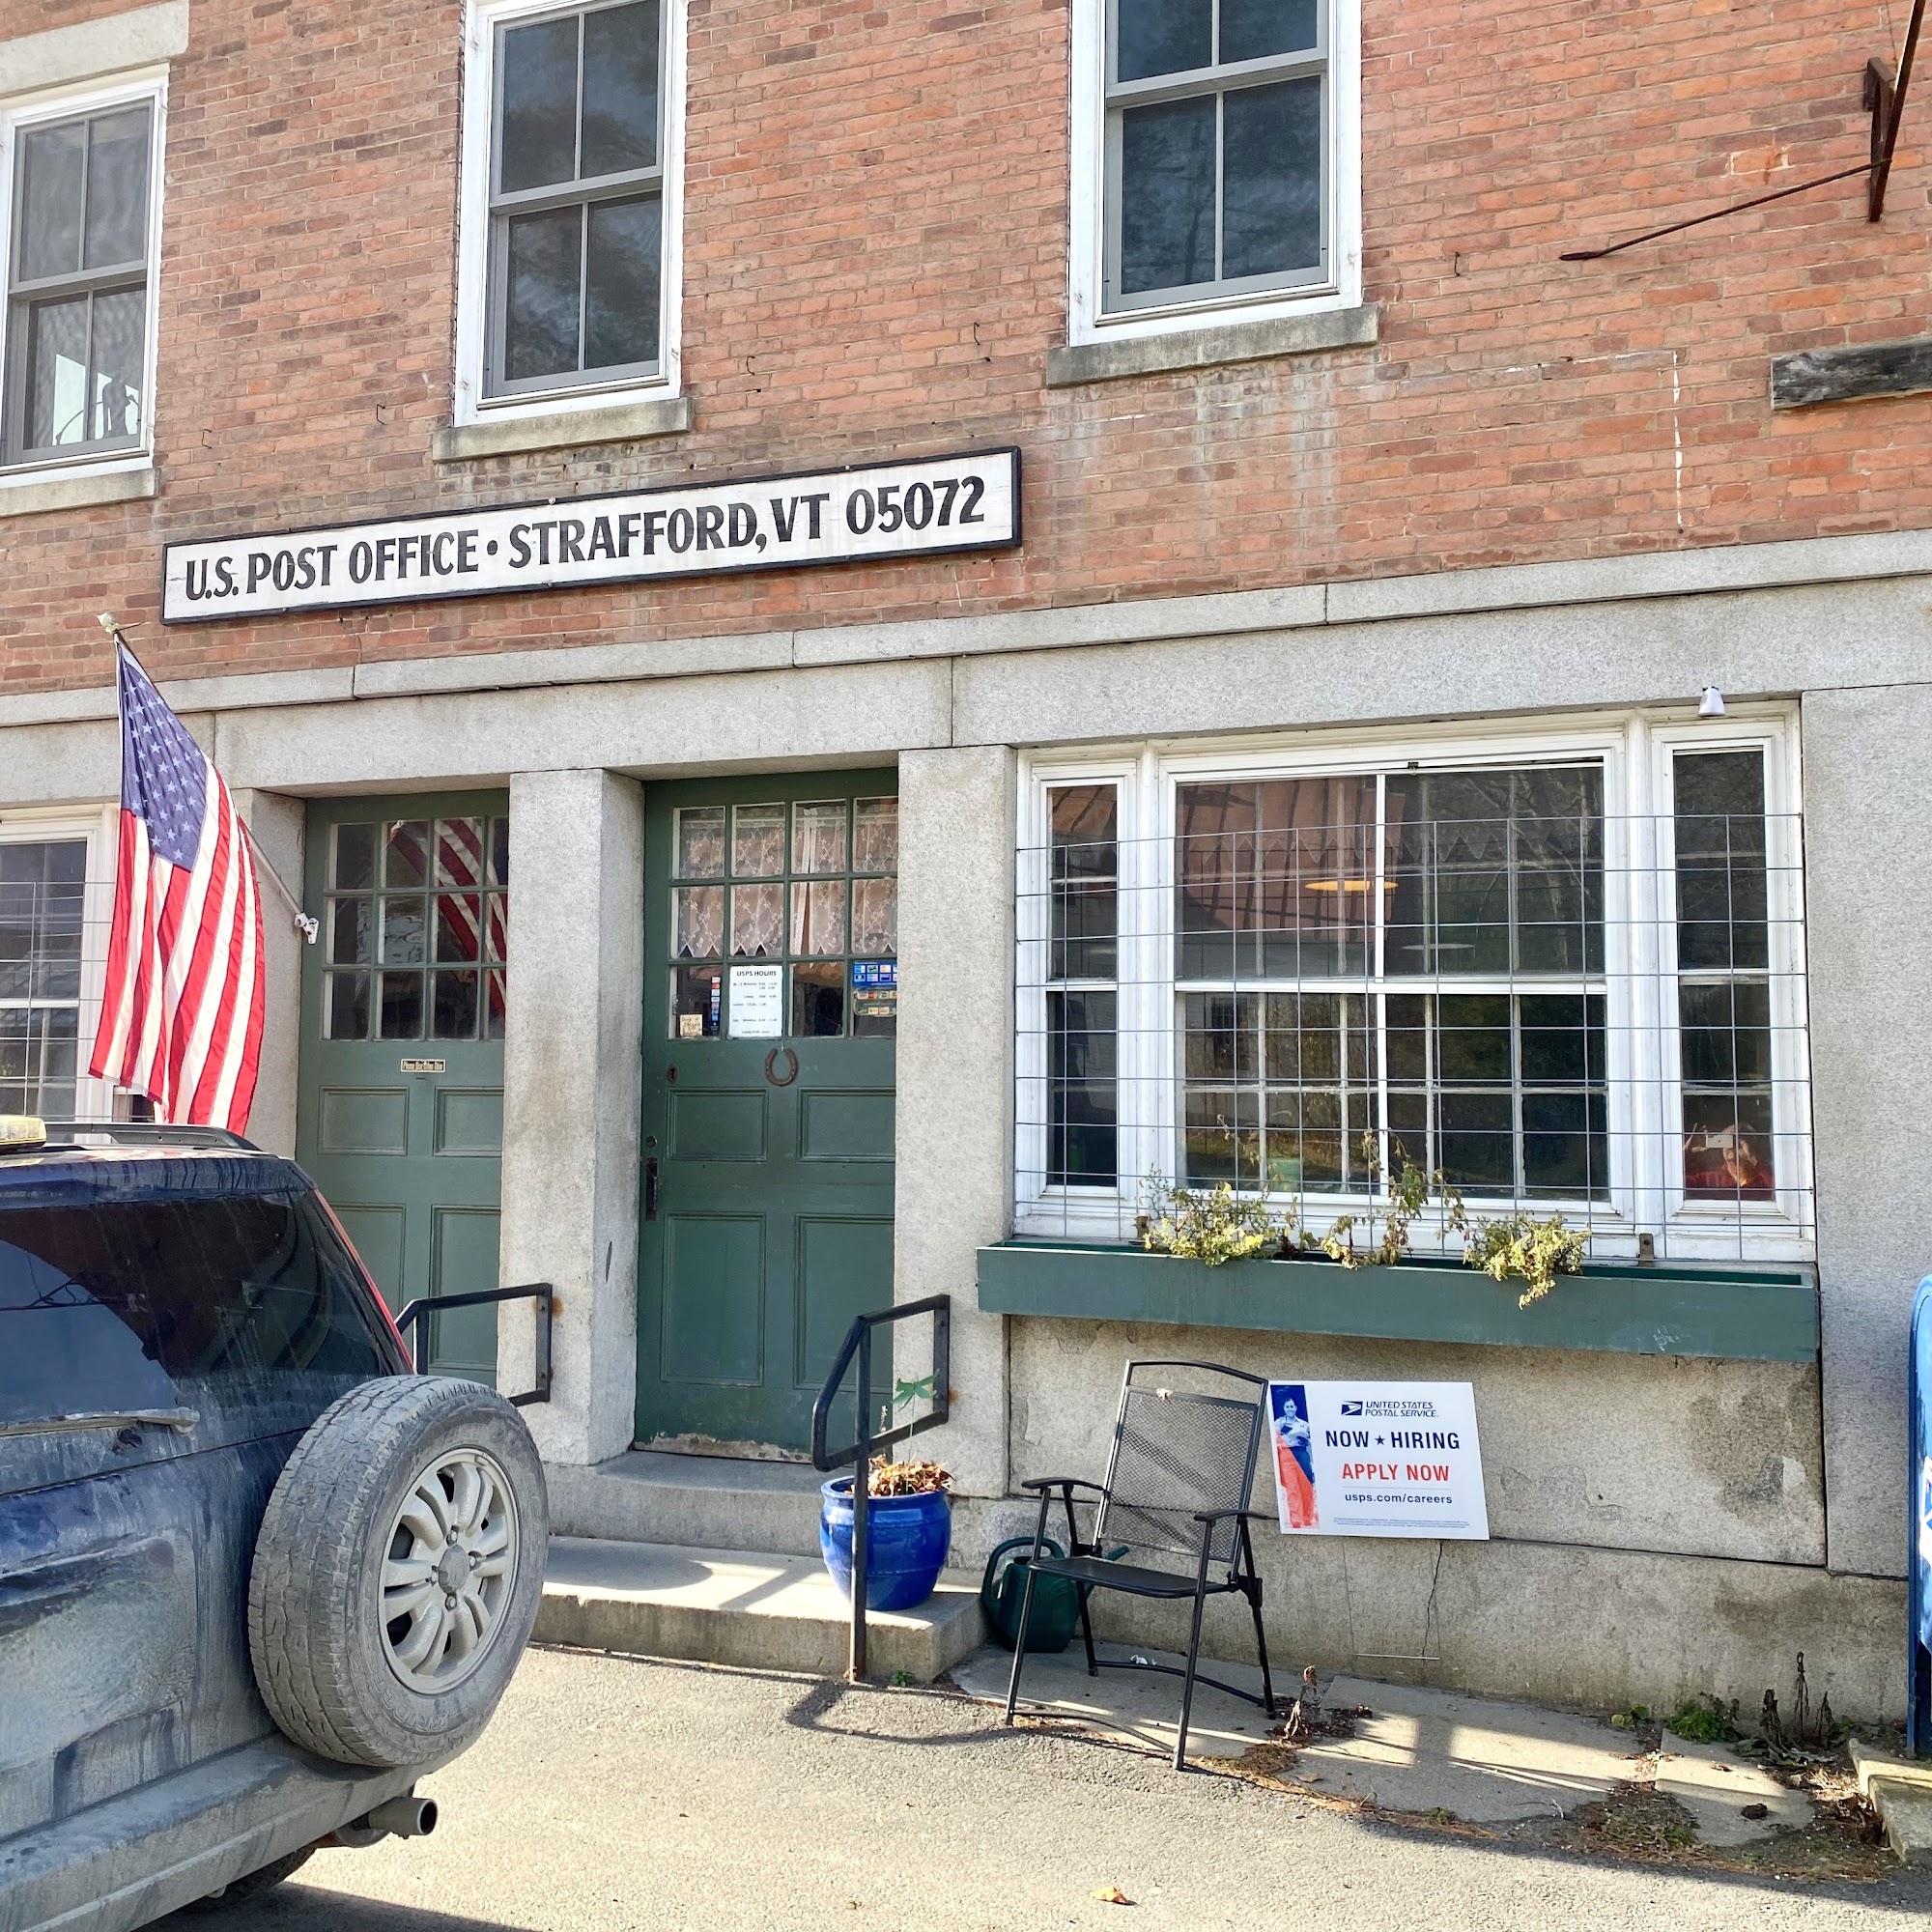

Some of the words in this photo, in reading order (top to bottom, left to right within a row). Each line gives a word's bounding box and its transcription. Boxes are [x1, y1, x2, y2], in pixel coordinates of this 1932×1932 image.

[185, 556, 239, 601] U.S.
[246, 544, 338, 594] POST
[349, 529, 479, 583] OFFICE
[769, 493, 830, 542] VT
[846, 474, 985, 535] 05072
[1325, 1430, 1369, 1448] NOW
[1390, 1431, 1460, 1449] HIRING
[1342, 1463, 1399, 1481] APPLY
[1406, 1464, 1449, 1482] NOW
[1345, 1492, 1453, 1503] usps.com/careers
